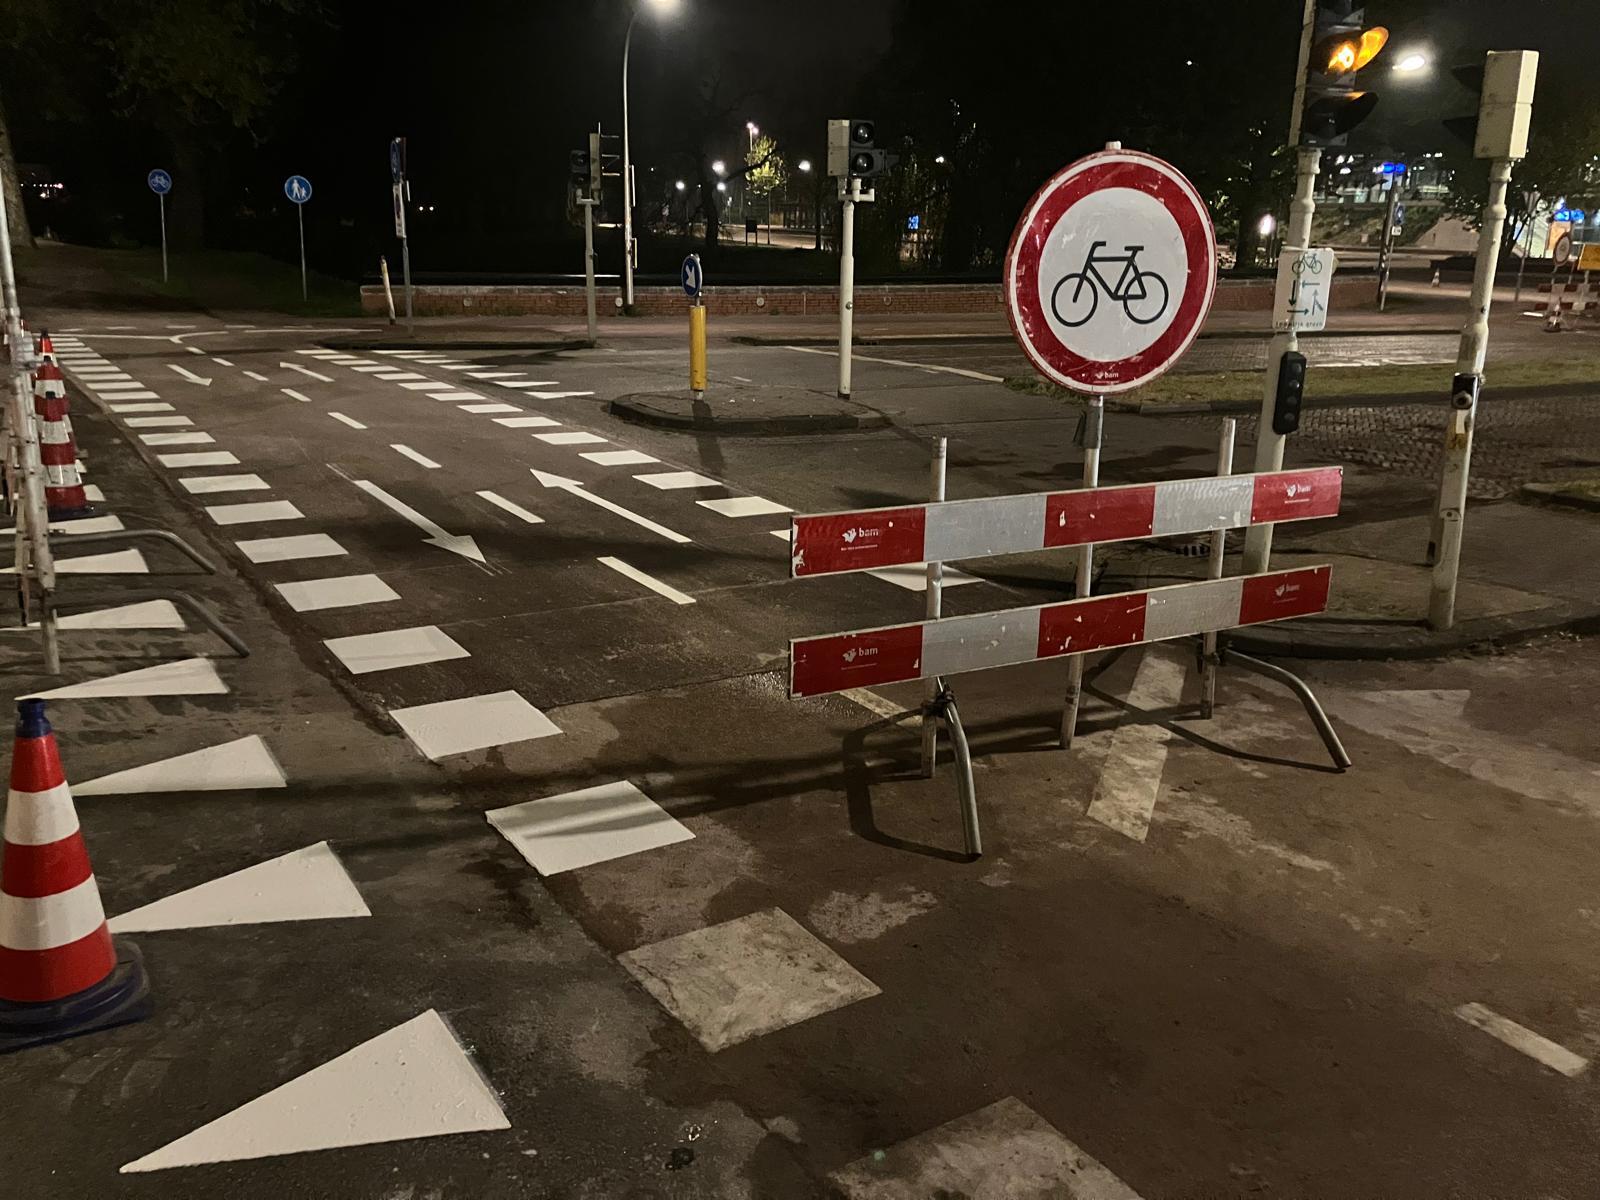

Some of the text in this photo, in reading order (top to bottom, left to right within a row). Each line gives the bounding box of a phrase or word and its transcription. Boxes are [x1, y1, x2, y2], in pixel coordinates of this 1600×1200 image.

[1104, 371, 1119, 379] bam
[858, 527, 879, 538] bam
[858, 647, 878, 657] bam
